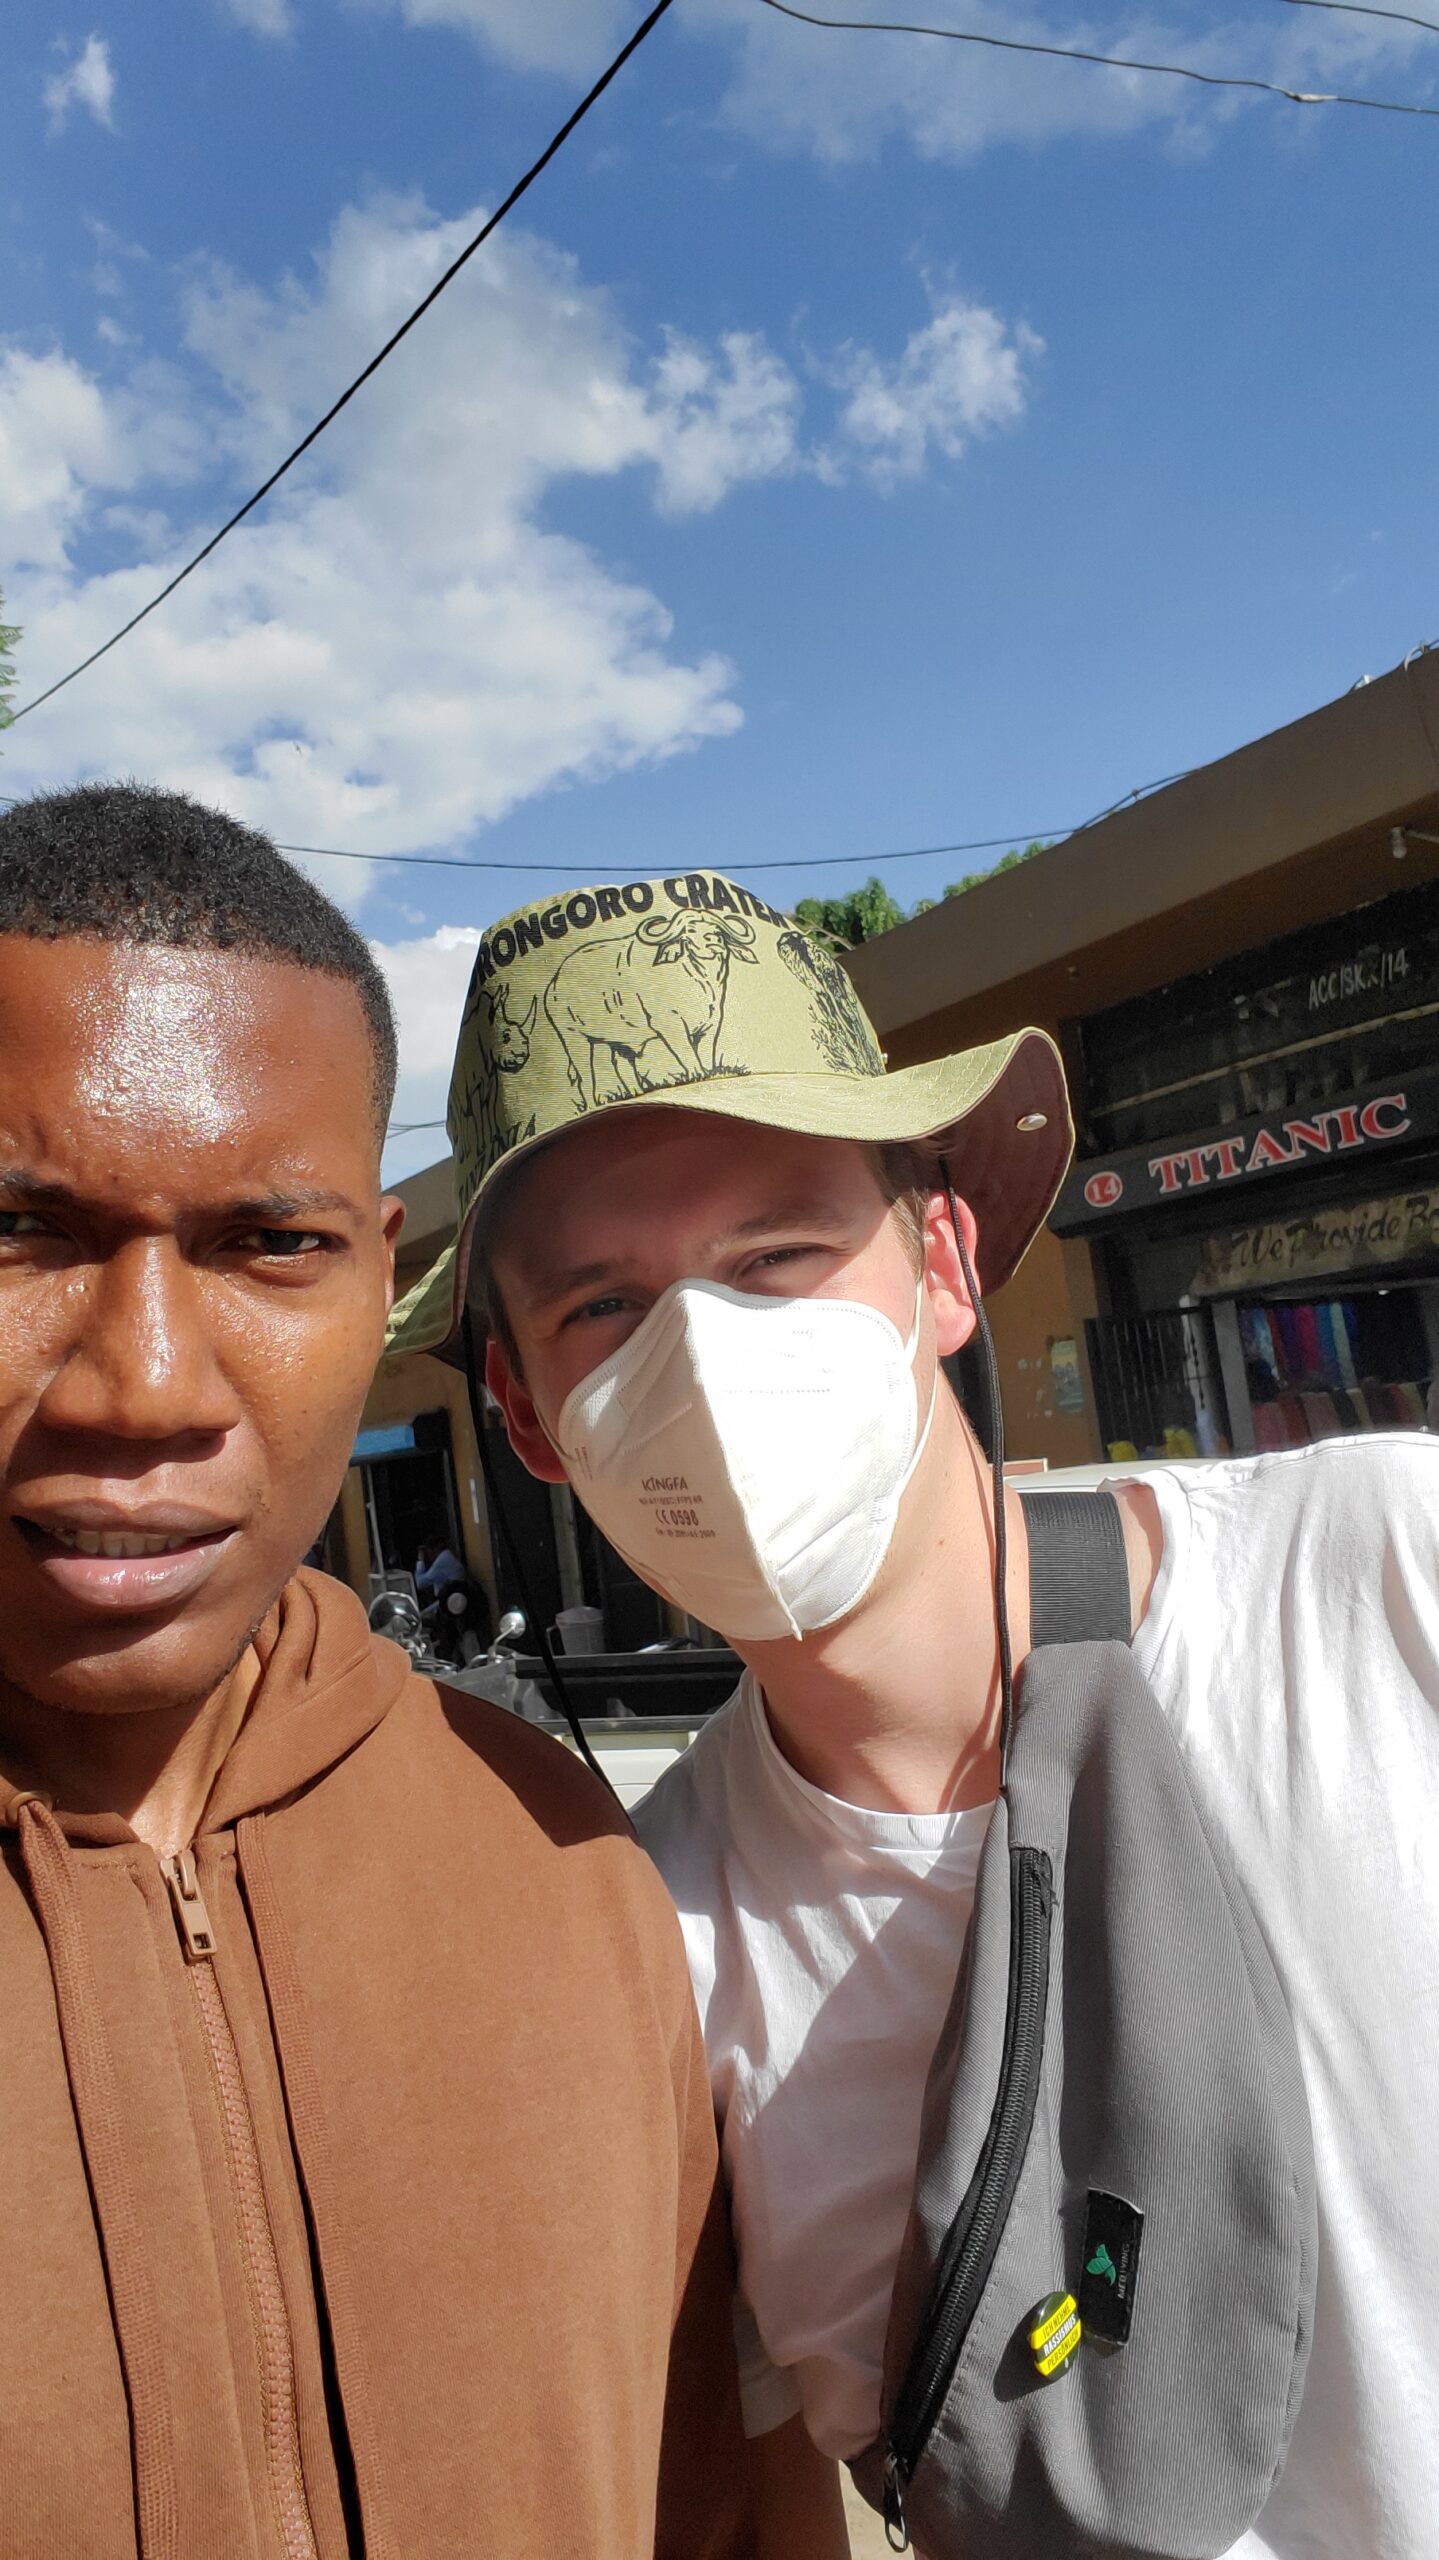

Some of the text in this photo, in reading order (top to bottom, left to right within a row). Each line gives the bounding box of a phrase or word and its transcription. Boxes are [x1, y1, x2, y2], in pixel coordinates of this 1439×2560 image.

[1091, 1093, 1411, 1202] 14 TITANIC
[1232, 1229, 1283, 1267] We
[642, 1477, 688, 1491] KINGFA
[670, 1509, 699, 1526] 0598
[1043, 2313, 1076, 2356] RASSISMUS
